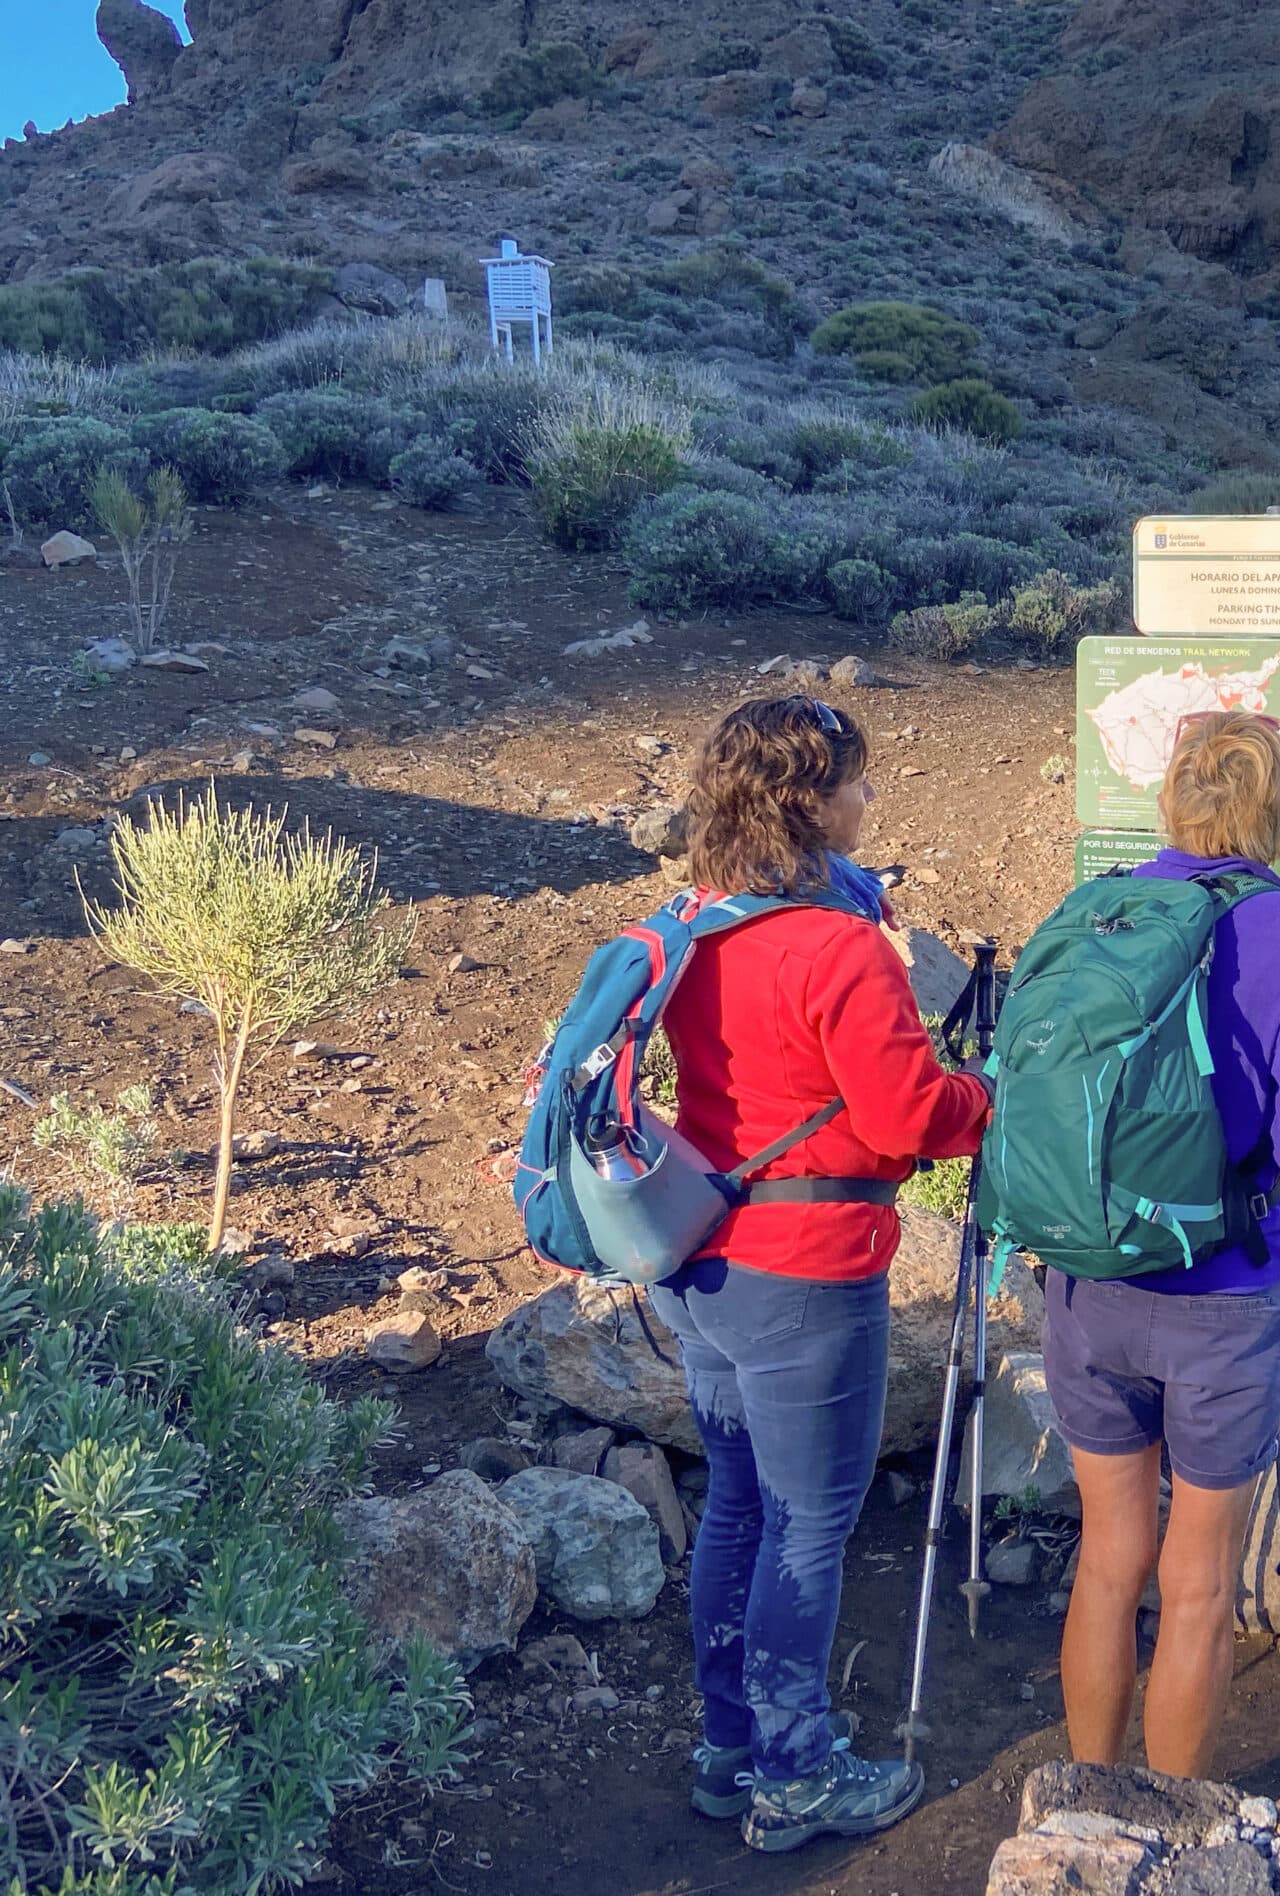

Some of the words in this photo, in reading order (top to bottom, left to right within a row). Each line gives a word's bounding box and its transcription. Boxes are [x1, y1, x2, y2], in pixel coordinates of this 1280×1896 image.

[1191, 573, 1239, 582] HORARIO
[1242, 573, 1263, 582] DEL
[1210, 586, 1238, 594] LUNES
[1239, 586, 1246, 594] A
[1217, 605, 1263, 614] PARKING
[1104, 647, 1121, 655] RED
[1123, 647, 1135, 655] DE
[1137, 647, 1182, 656] SENDEROS
[1183, 648, 1207, 656] TRAIL
[1208, 648, 1251, 657] NETWORK
[1083, 840, 1101, 849] POR
[1102, 840, 1114, 849] SU
